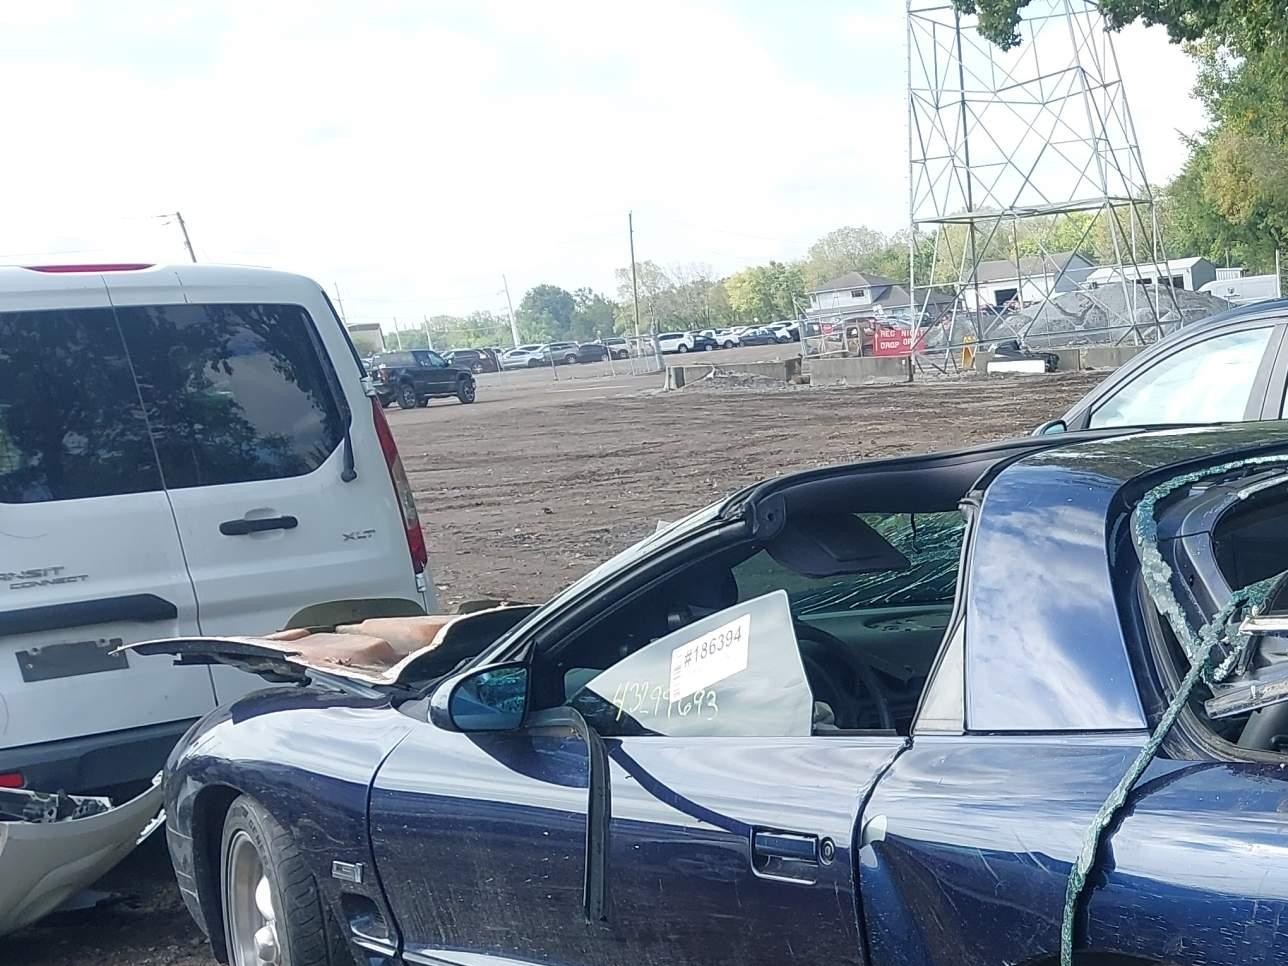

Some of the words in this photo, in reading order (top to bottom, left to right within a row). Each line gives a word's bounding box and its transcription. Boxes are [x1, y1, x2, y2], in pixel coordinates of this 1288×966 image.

[342, 529, 376, 542] XLT
[9, 574, 89, 590] CONNECT
[683, 625, 742, 667] #186394
